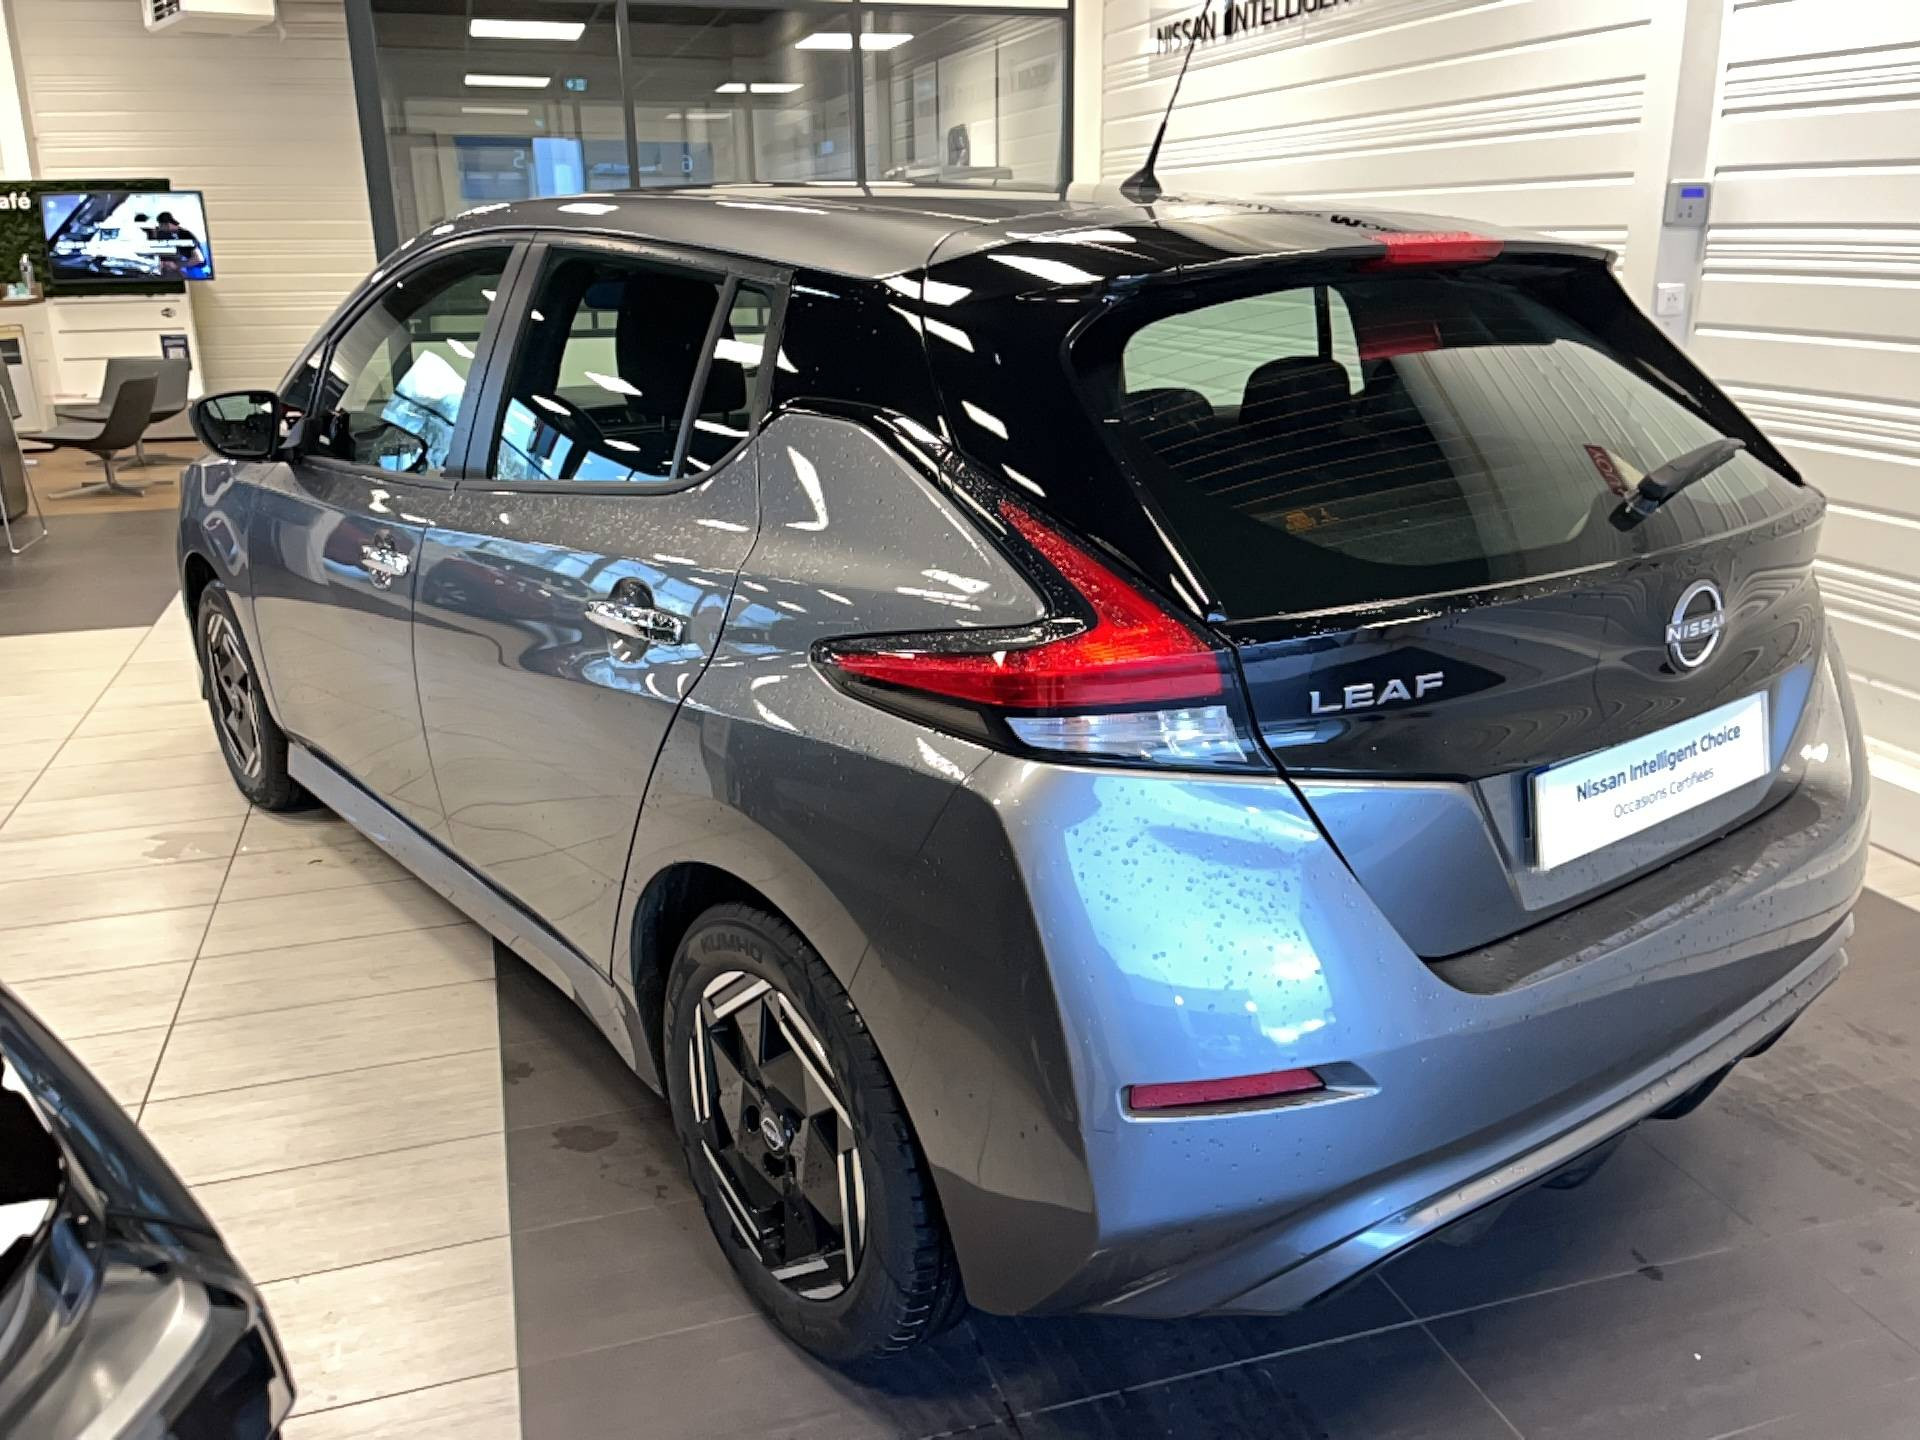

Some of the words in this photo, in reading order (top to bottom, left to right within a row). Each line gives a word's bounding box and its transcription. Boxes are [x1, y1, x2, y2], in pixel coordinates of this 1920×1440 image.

[1157, 10, 1217, 54] NISSAN
[1224, 0, 1348, 36] INTELLI
[1309, 671, 1444, 714] LEAF
[1577, 770, 1626, 801] Nissan
[1629, 740, 1698, 782] Intelligent
[1700, 725, 1741, 752] Choice
[1614, 787, 1667, 818] Occasions
